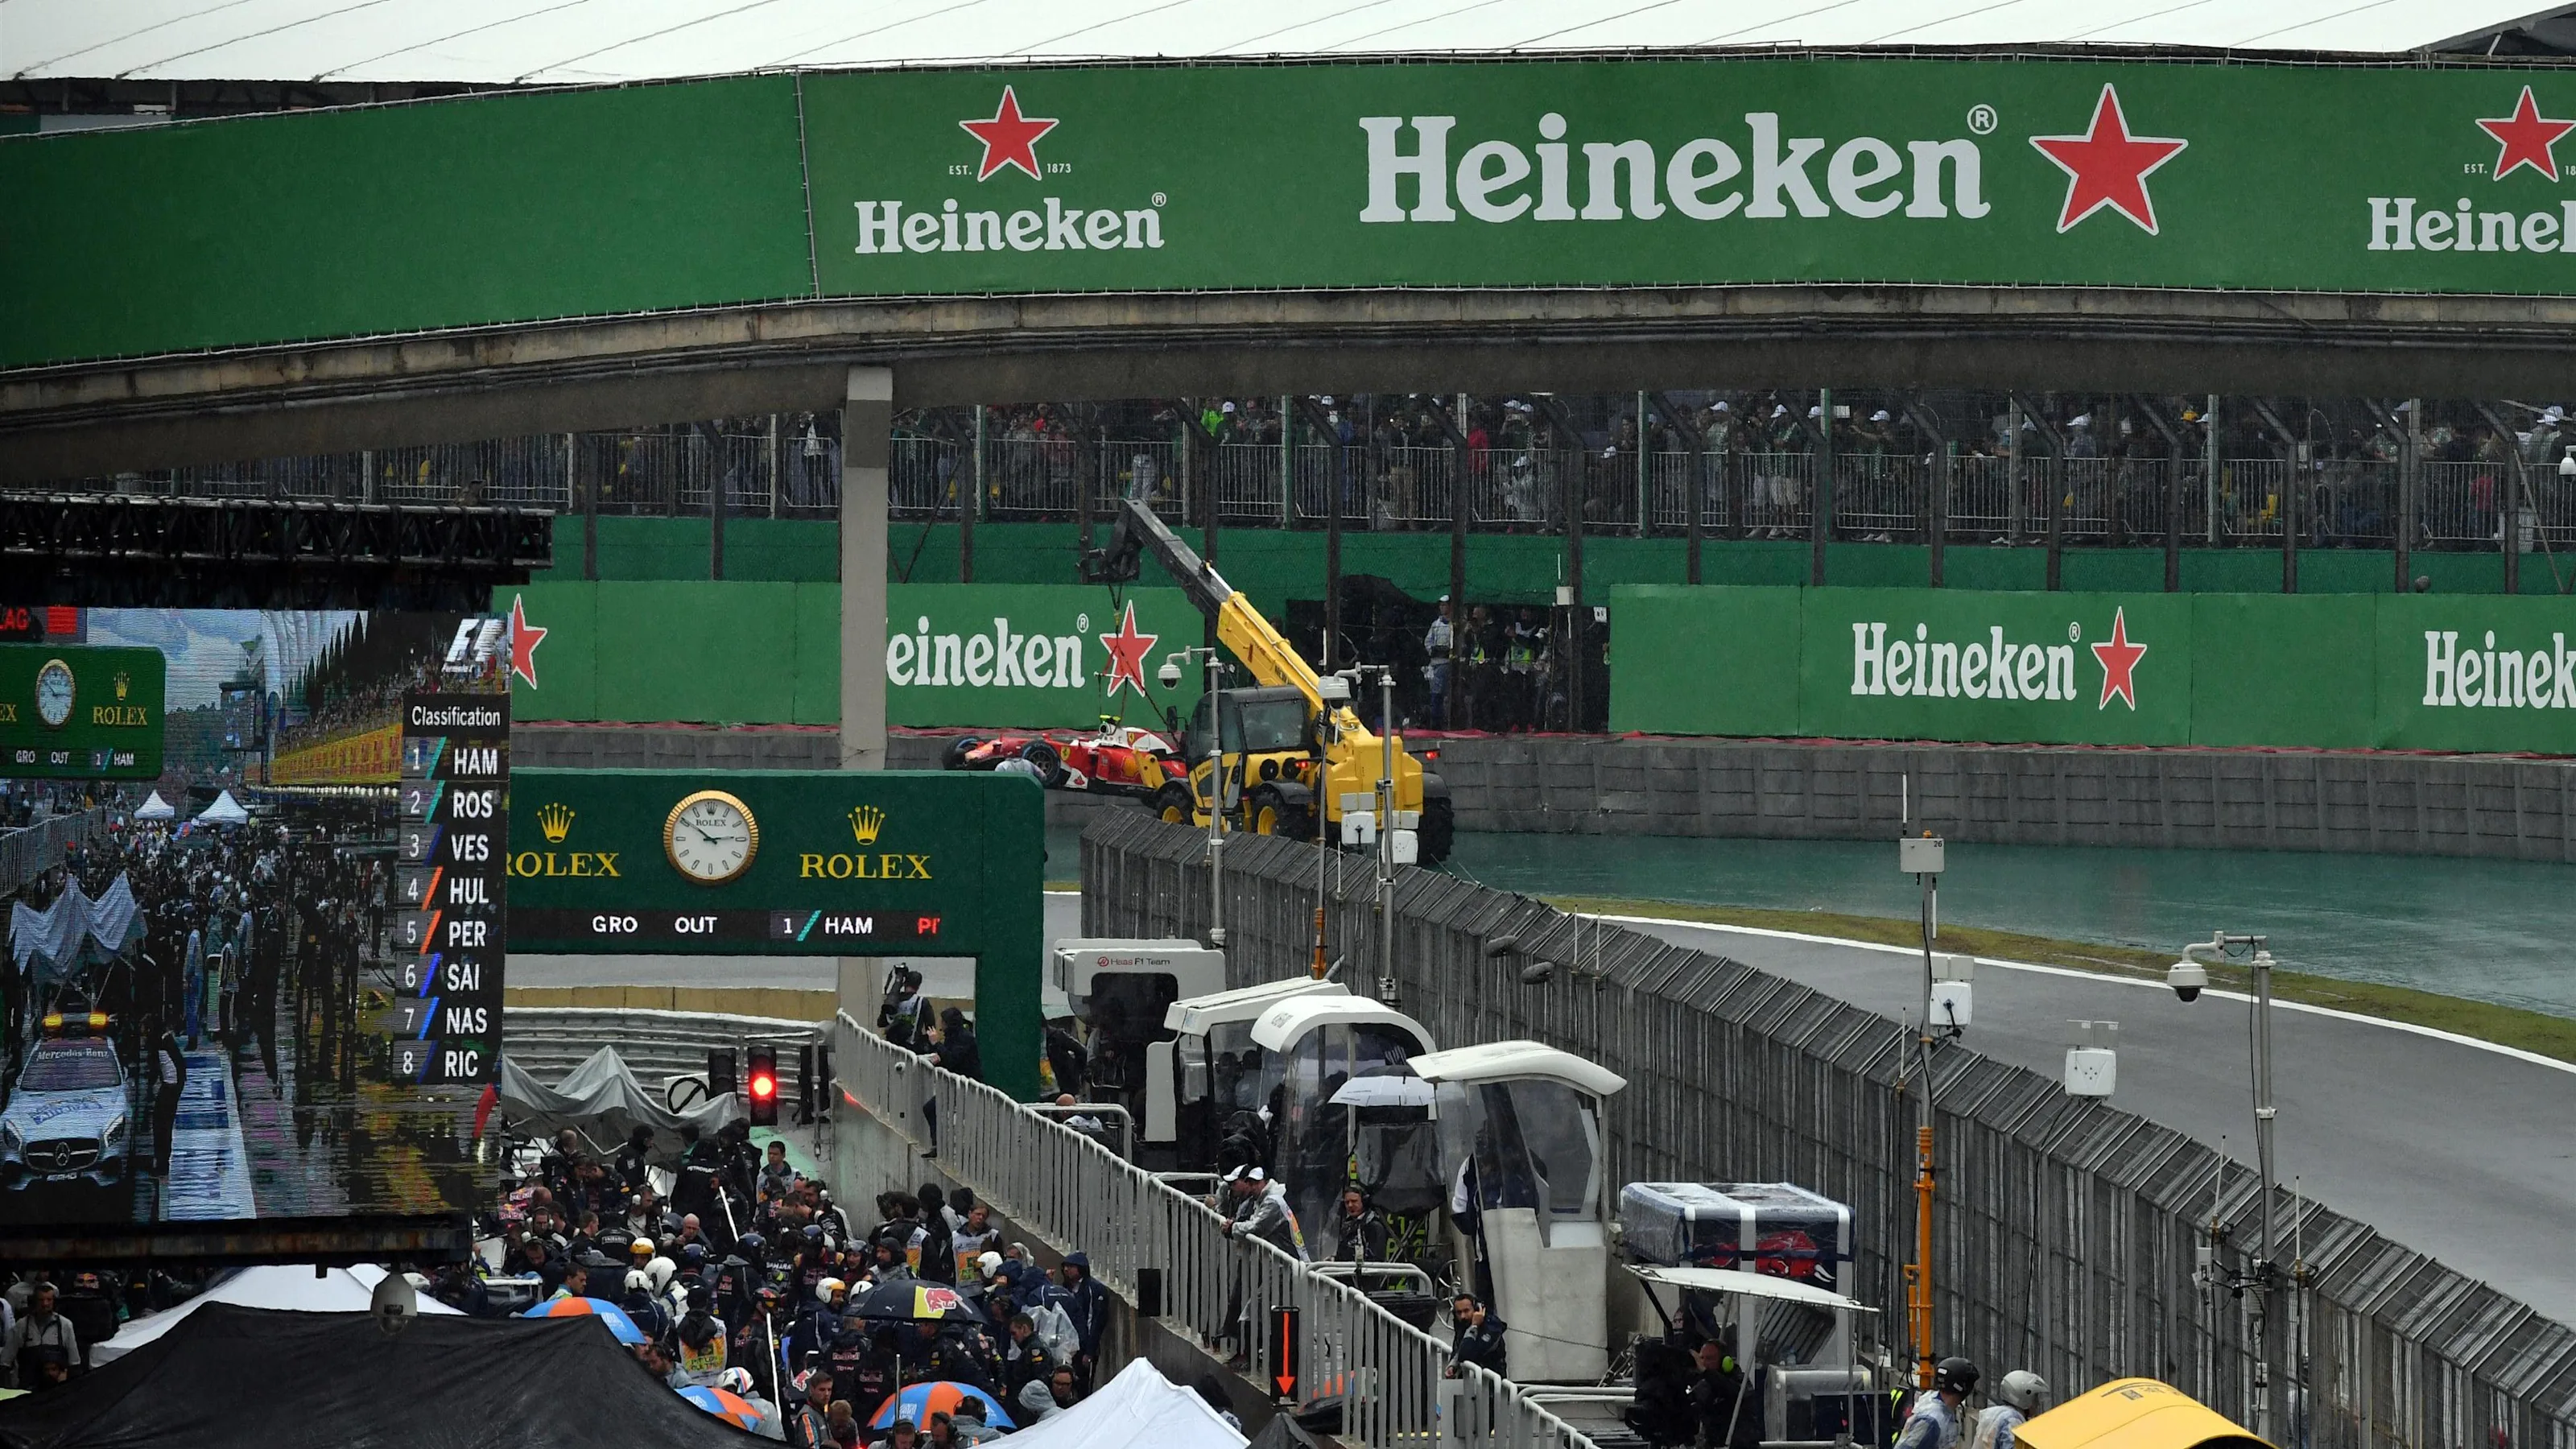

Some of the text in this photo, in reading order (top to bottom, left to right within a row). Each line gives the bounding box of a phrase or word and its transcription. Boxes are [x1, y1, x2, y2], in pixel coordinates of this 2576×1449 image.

[948, 163, 1071, 175] EST. 1873
[1360, 113, 1991, 223] Heineken
[2463, 163, 2487, 174] EST.
[854, 197, 1166, 254] Heineken
[0, 608, 30, 630] AG
[886, 616, 1085, 688] eineken
[1851, 622, 2078, 701] Heineken
[93, 706, 148, 725] ROLEX
[411, 705, 501, 727] Classification
[15, 749, 35, 764] GRO
[51, 751, 70, 765] OUT
[114, 753, 134, 766] HAM
[412, 747, 497, 774] 1 HAM
[411, 791, 493, 818] 2 ROS
[696, 819, 727, 827] ROLEX
[409, 834, 489, 861] 3 VES
[799, 853, 933, 879] ROLEX
[407, 877, 489, 904] 4 HUL
[407, 920, 486, 947] 5 PER
[592, 915, 638, 933] GRO
[675, 916, 717, 933] OUT
[783, 918, 793, 934] 1
[824, 917, 873, 935] HAM
[1134, 957, 1143, 965] F1
[405, 964, 480, 991] 6 SAI
[404, 1007, 488, 1034] 7 NAS
[402, 1051, 478, 1077] 8 RIC
